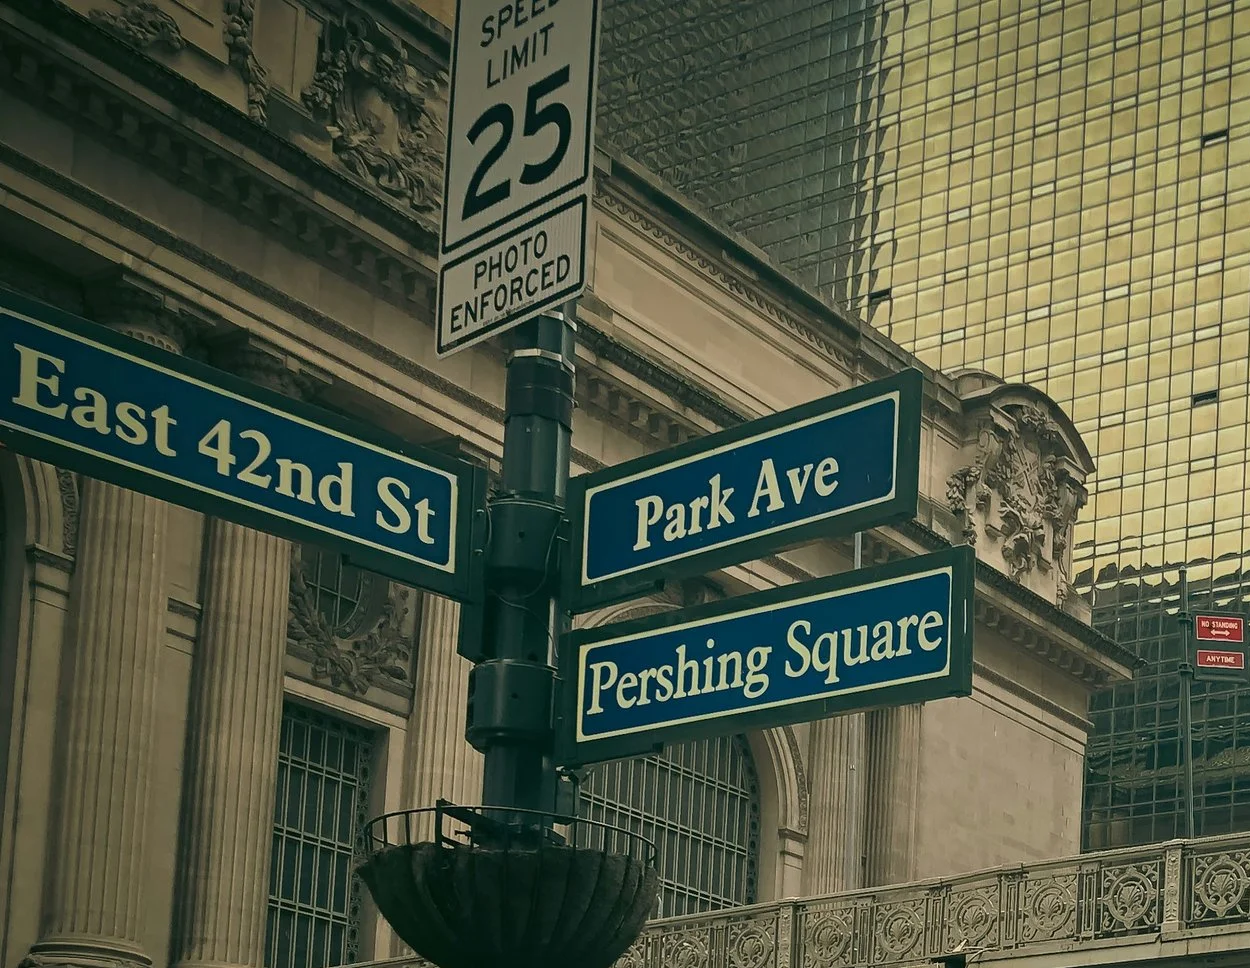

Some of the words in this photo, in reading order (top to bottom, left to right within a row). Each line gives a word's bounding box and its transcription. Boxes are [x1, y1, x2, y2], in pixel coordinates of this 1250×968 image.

[480, 0, 560, 47] SPEE
[487, 22, 554, 89] LIMIT
[462, 64, 571, 221] 25
[450, 254, 570, 333] ENFORCED
[474, 230, 547, 289] PHOTO
[12, 343, 177, 457] East
[198, 419, 356, 517] 42nd
[375, 476, 435, 545] St
[633, 473, 735, 551] Park
[747, 456, 839, 518] Ave
[1206, 655, 1236, 664] ANYTIME
[1212, 621, 1238, 630] STANDING
[586, 639, 772, 716] Pershing
[785, 610, 943, 684] Square
